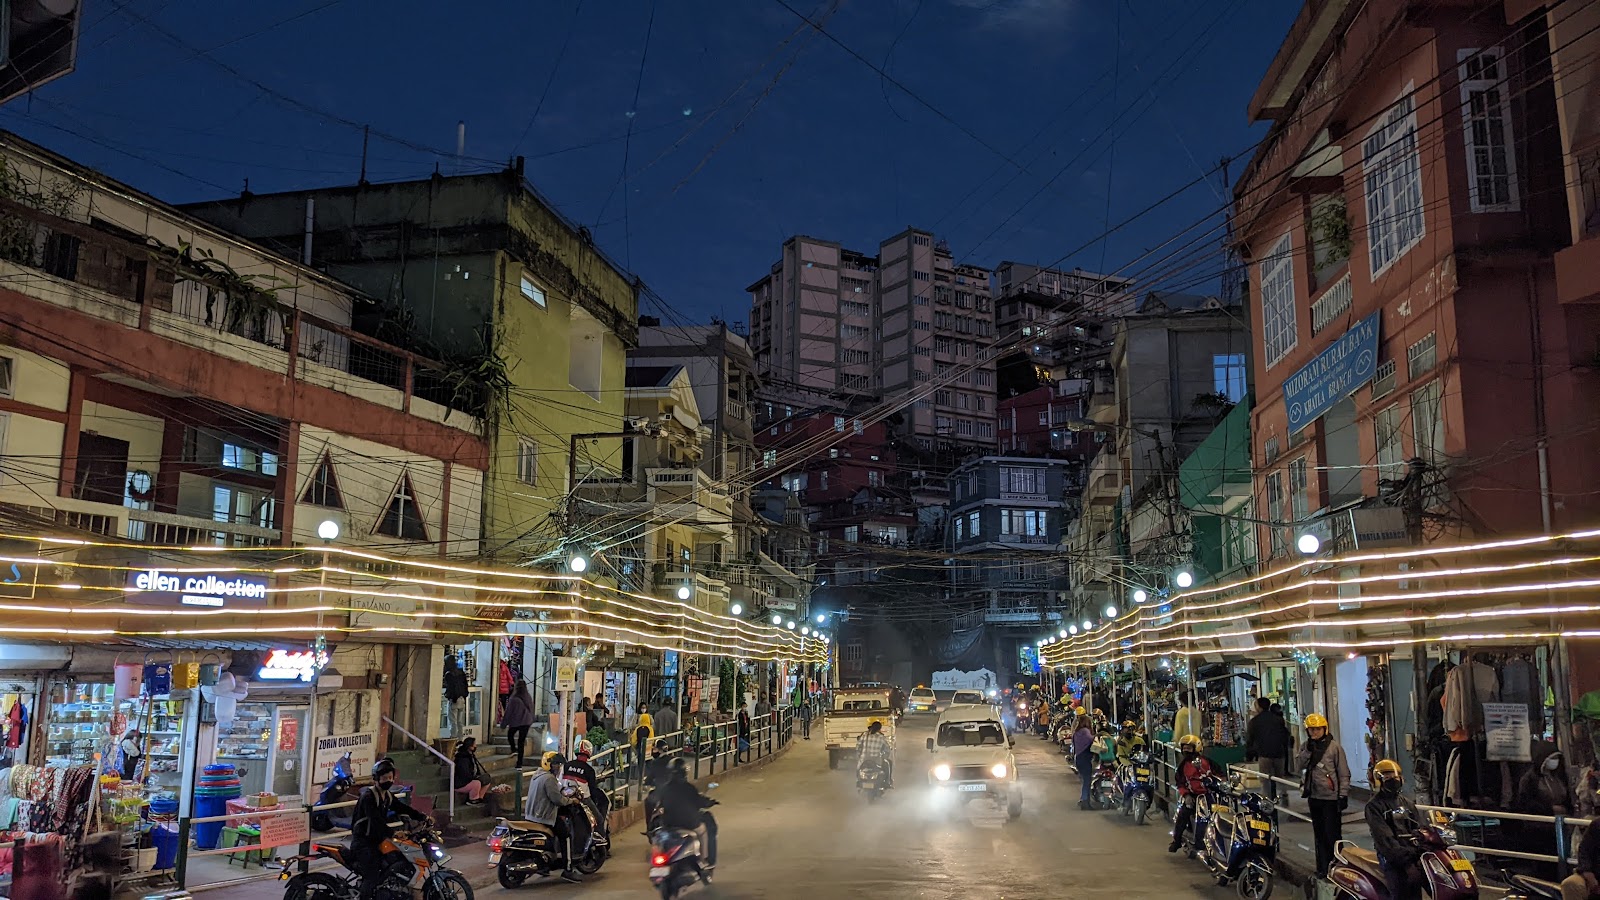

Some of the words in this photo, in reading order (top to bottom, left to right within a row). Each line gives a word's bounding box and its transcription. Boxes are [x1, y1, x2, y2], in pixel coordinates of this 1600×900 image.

[1285, 362, 1319, 400] MIZORAM
[1320, 339, 1347, 373] RURAL
[1349, 320, 1373, 352] BANK
[1303, 391, 1326, 416] KHATLA
[1328, 368, 1352, 398] BRANCH
[136, 570, 180, 591] ellen
[185, 575, 265, 598] collection
[318, 737, 338, 750] ZORIN
[338, 733, 372, 748] COLLECTION
